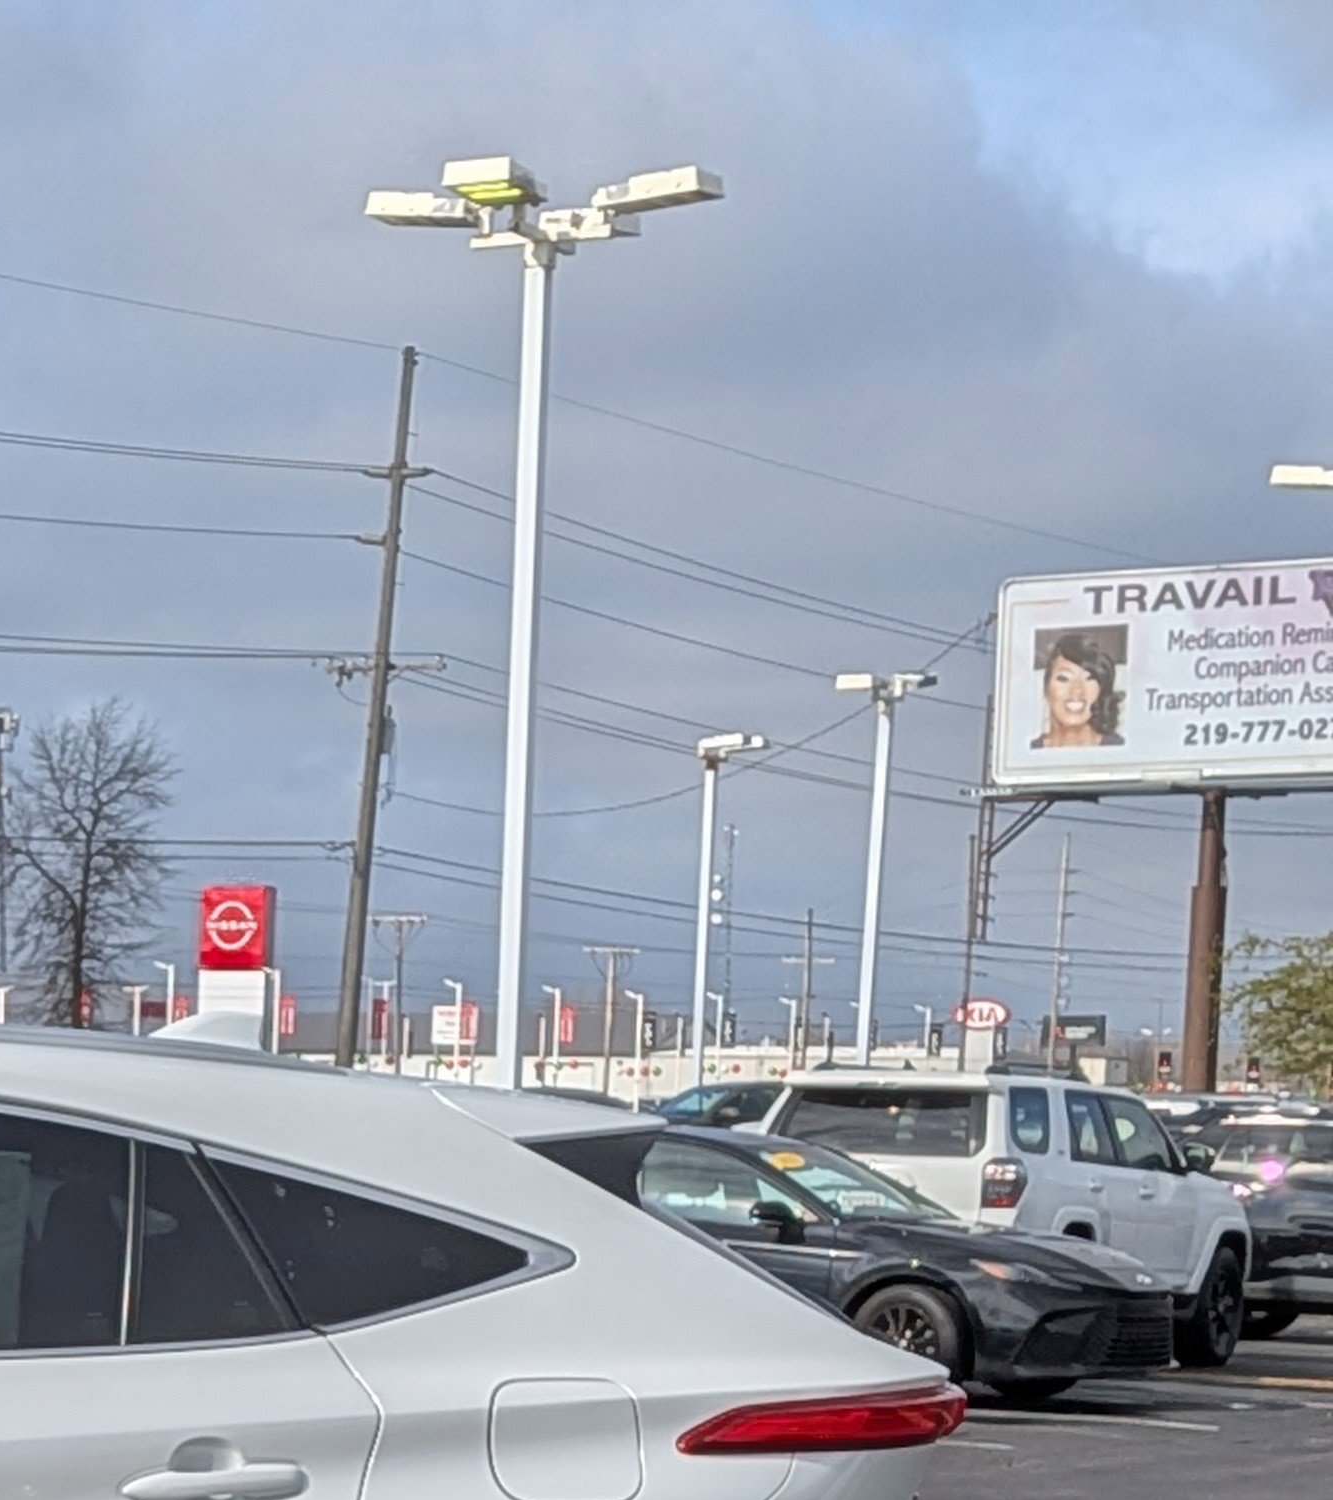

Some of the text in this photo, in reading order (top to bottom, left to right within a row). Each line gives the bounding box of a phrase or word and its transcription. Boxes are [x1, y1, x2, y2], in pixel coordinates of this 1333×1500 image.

[1083, 575, 1297, 615] TRAVAIL
[1167, 625, 1275, 652] Medication
[1194, 653, 1305, 682] Companion
[1145, 682, 1293, 714] Transportation
[1183, 717, 1333, 746] 219-777-02
